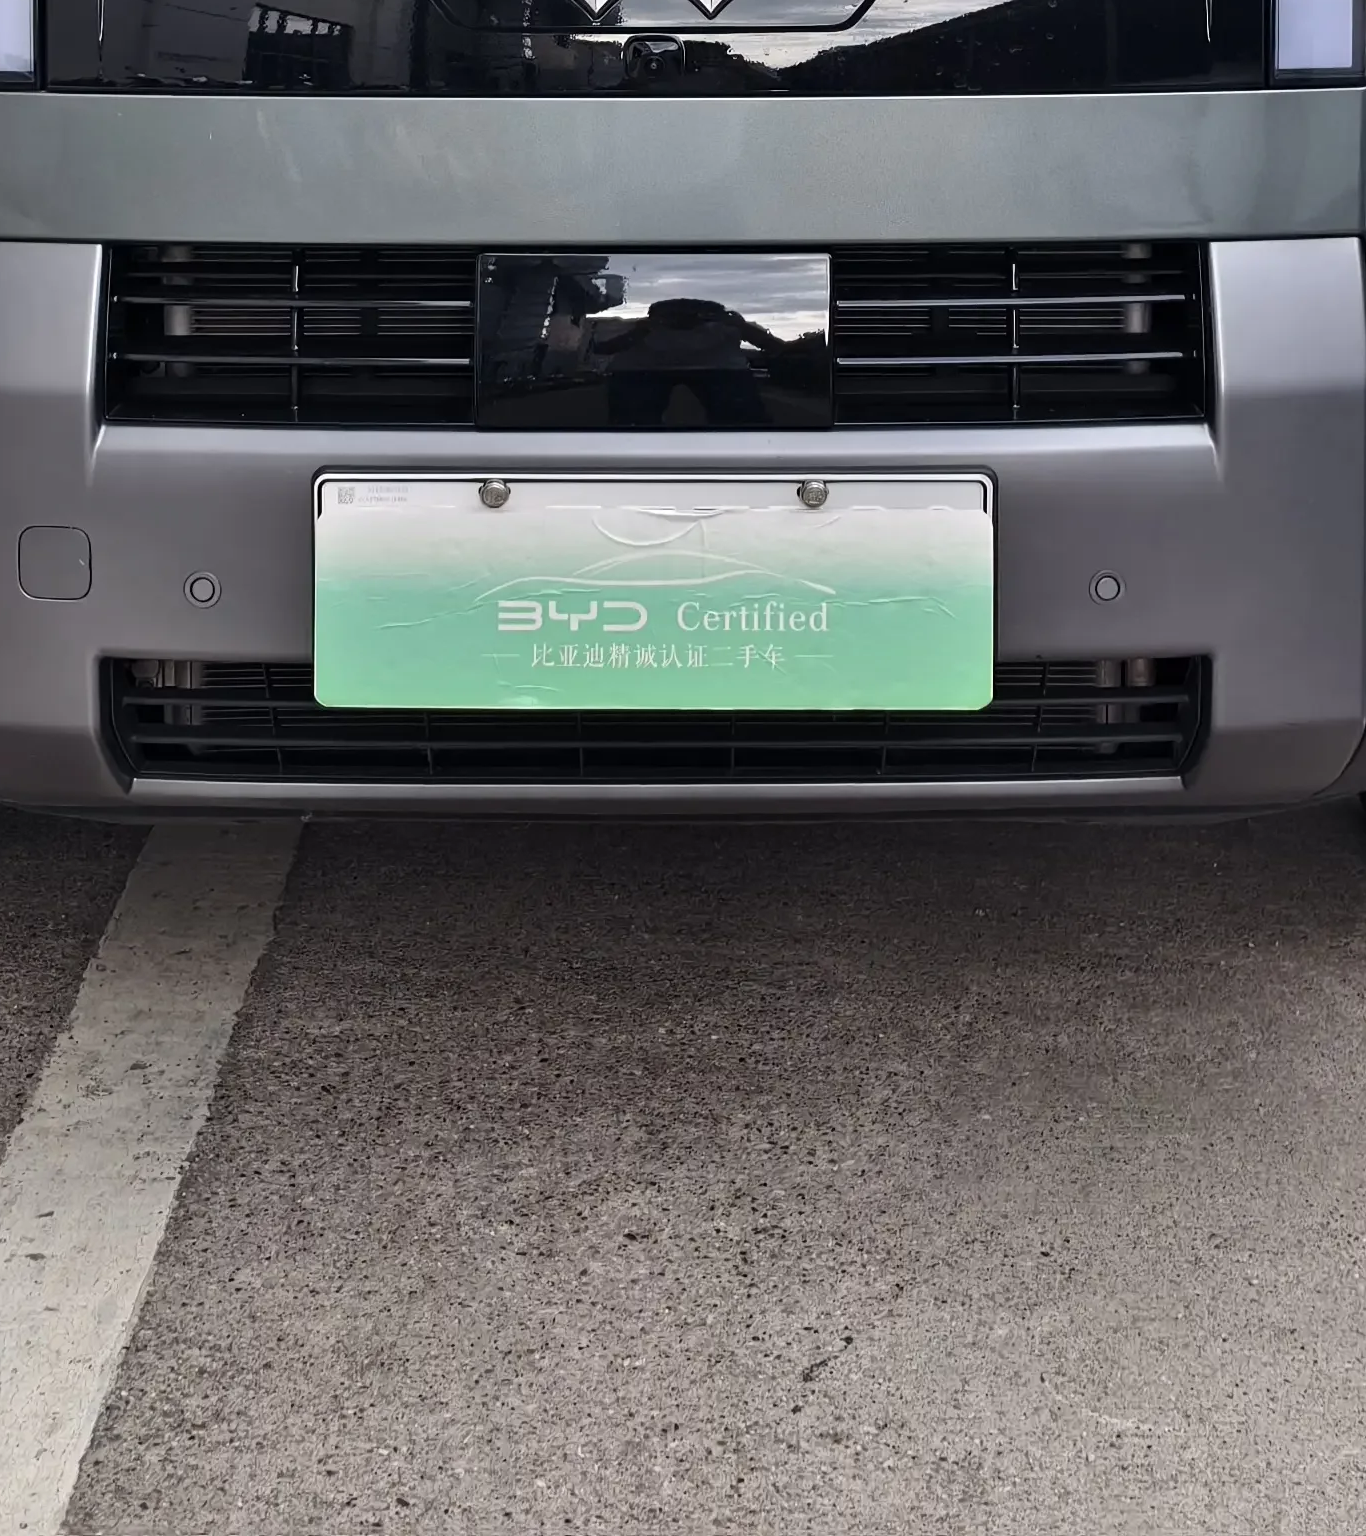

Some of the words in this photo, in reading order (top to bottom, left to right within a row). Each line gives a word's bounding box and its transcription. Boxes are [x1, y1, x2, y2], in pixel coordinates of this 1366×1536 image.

[498, 601, 647, 632] BYD
[677, 601, 830, 632] Certified
[531, 643, 786, 670] 比亚迪精诚认证二手车
